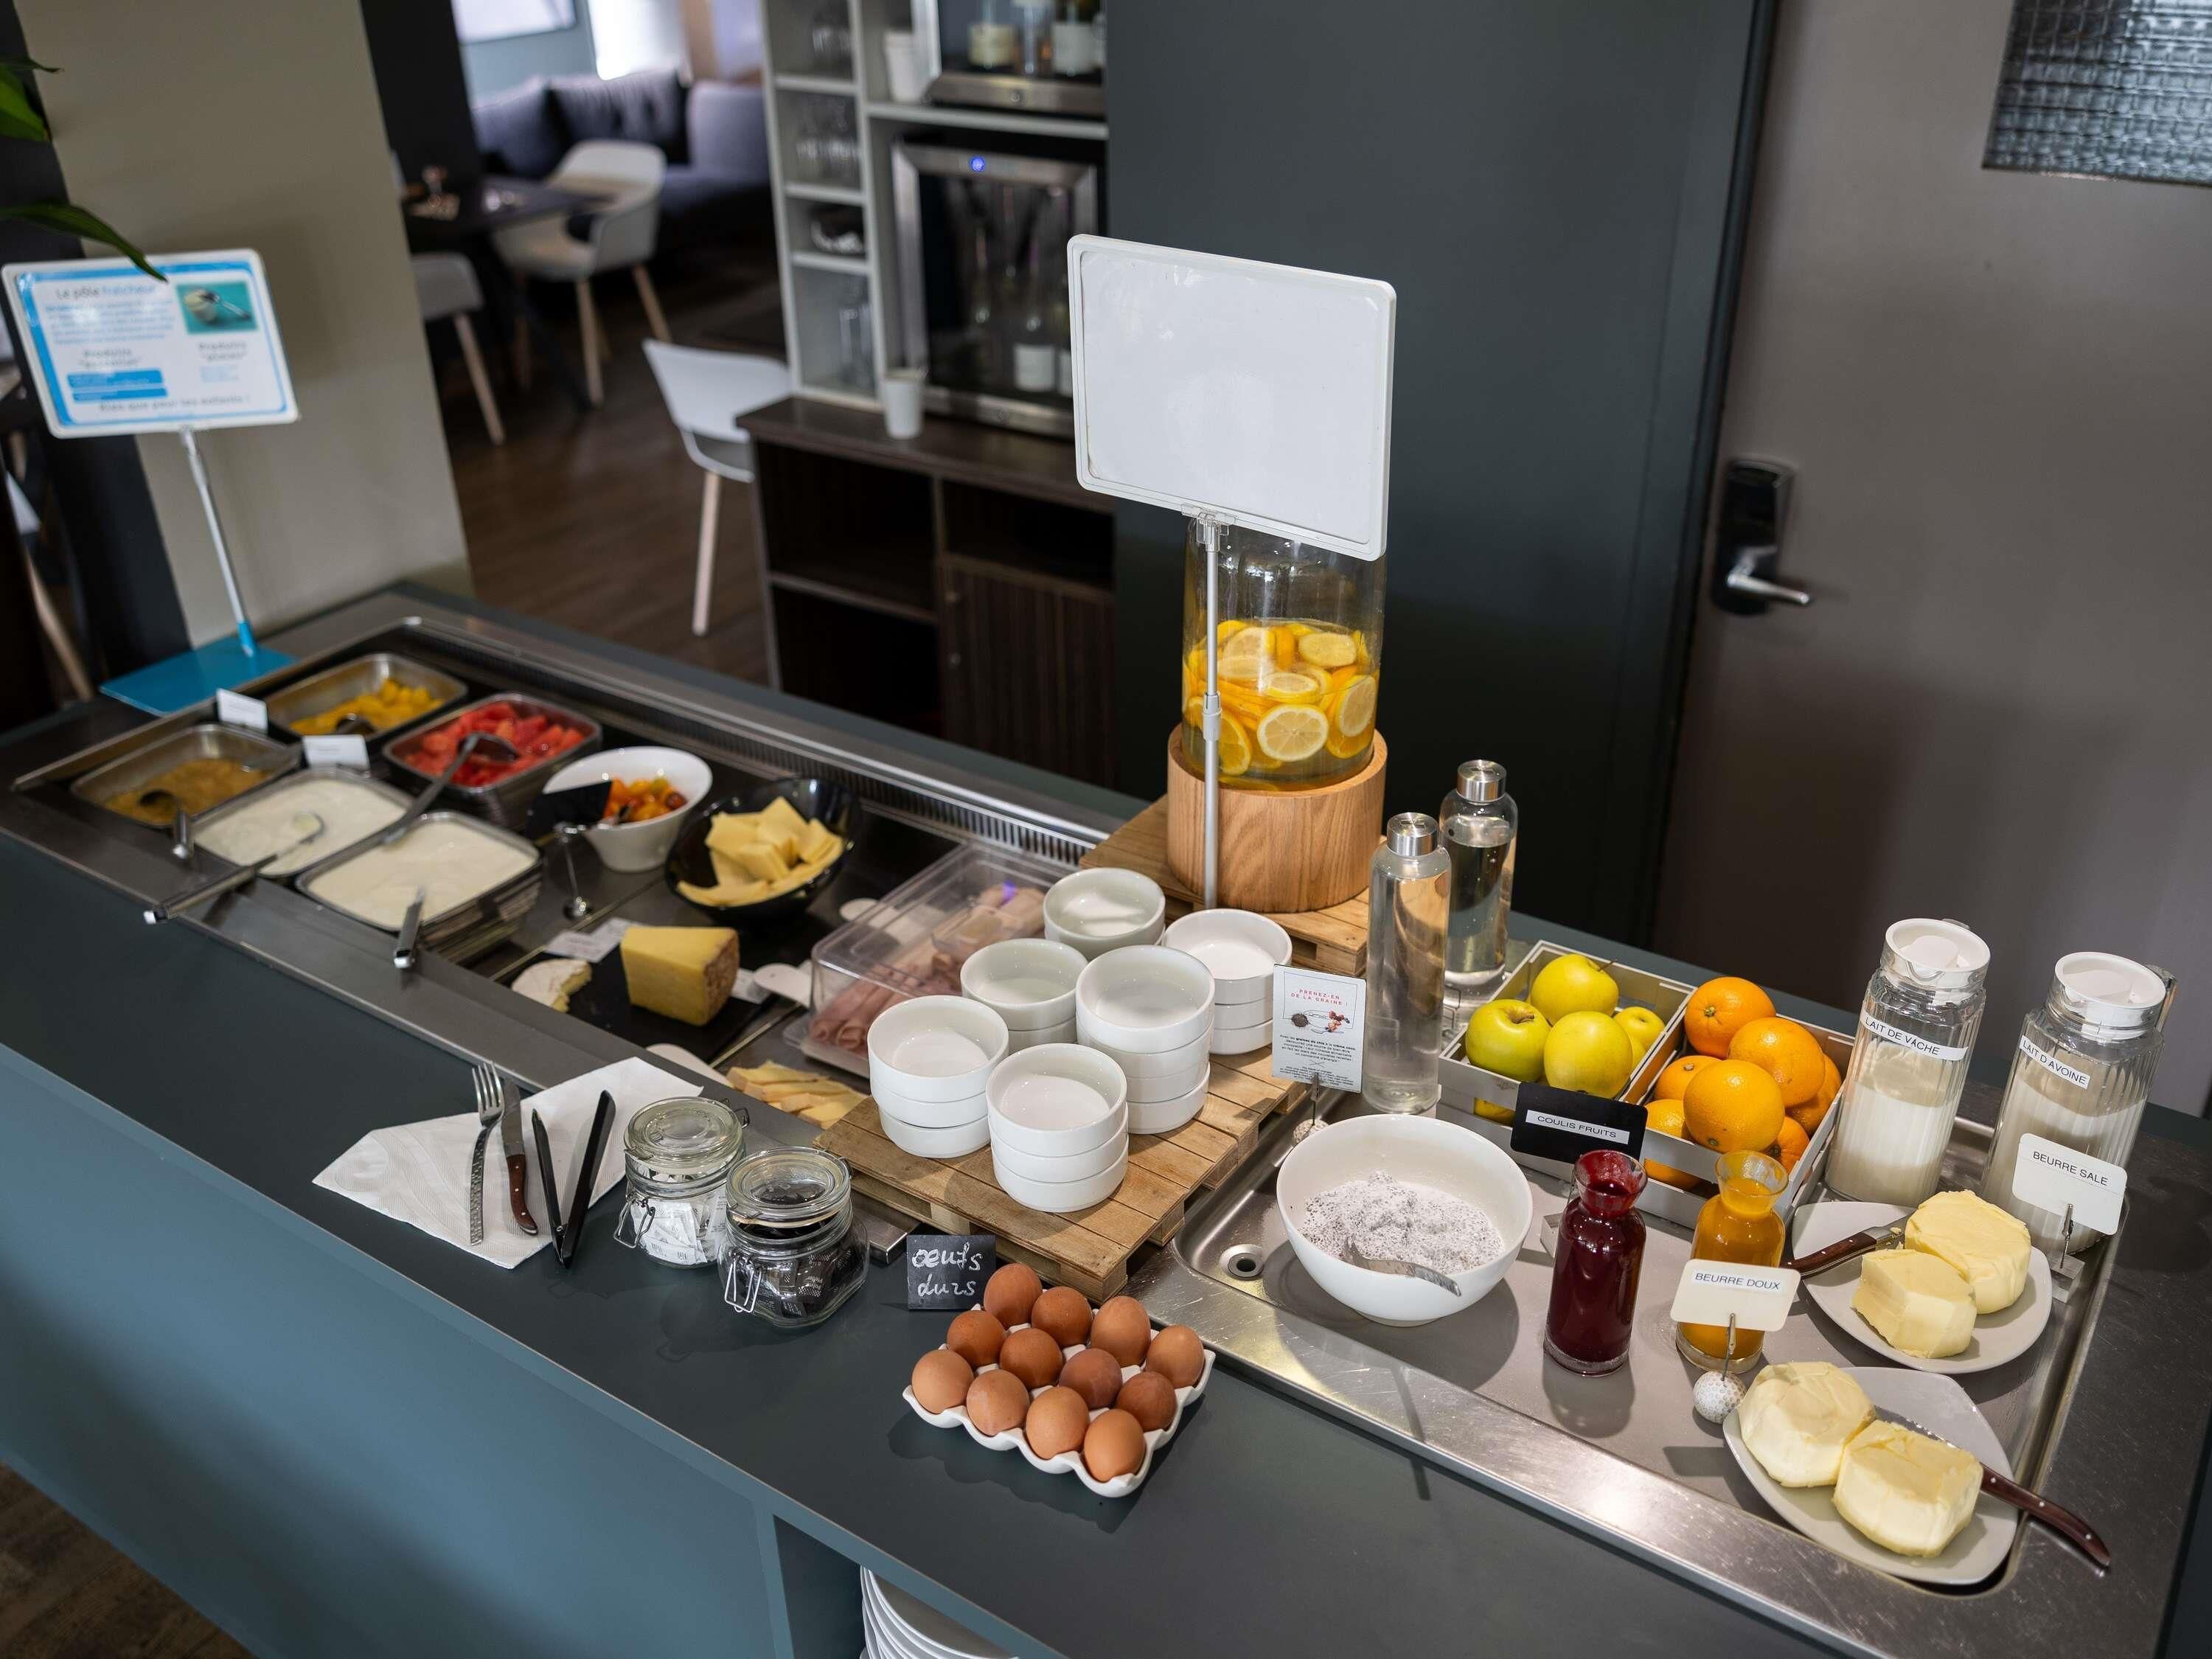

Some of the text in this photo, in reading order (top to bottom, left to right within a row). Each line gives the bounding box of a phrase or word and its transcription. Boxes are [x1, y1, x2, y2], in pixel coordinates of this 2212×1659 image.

[1299, 989, 1340, 1000] PRENEZ-EN
[1315, 997, 1343, 1006] GRAINE
[1865, 1017, 1941, 1056] LAIT DE VACHE
[2023, 1040, 2087, 1086] LAIT D AVOINE
[1537, 1115, 1616, 1138] COULIS FRUITS
[2033, 1150, 2108, 1186] BEURRE SALE
[918, 1273, 977, 1297] durs
[1695, 1272, 1782, 1290] BEURRE DOUX
